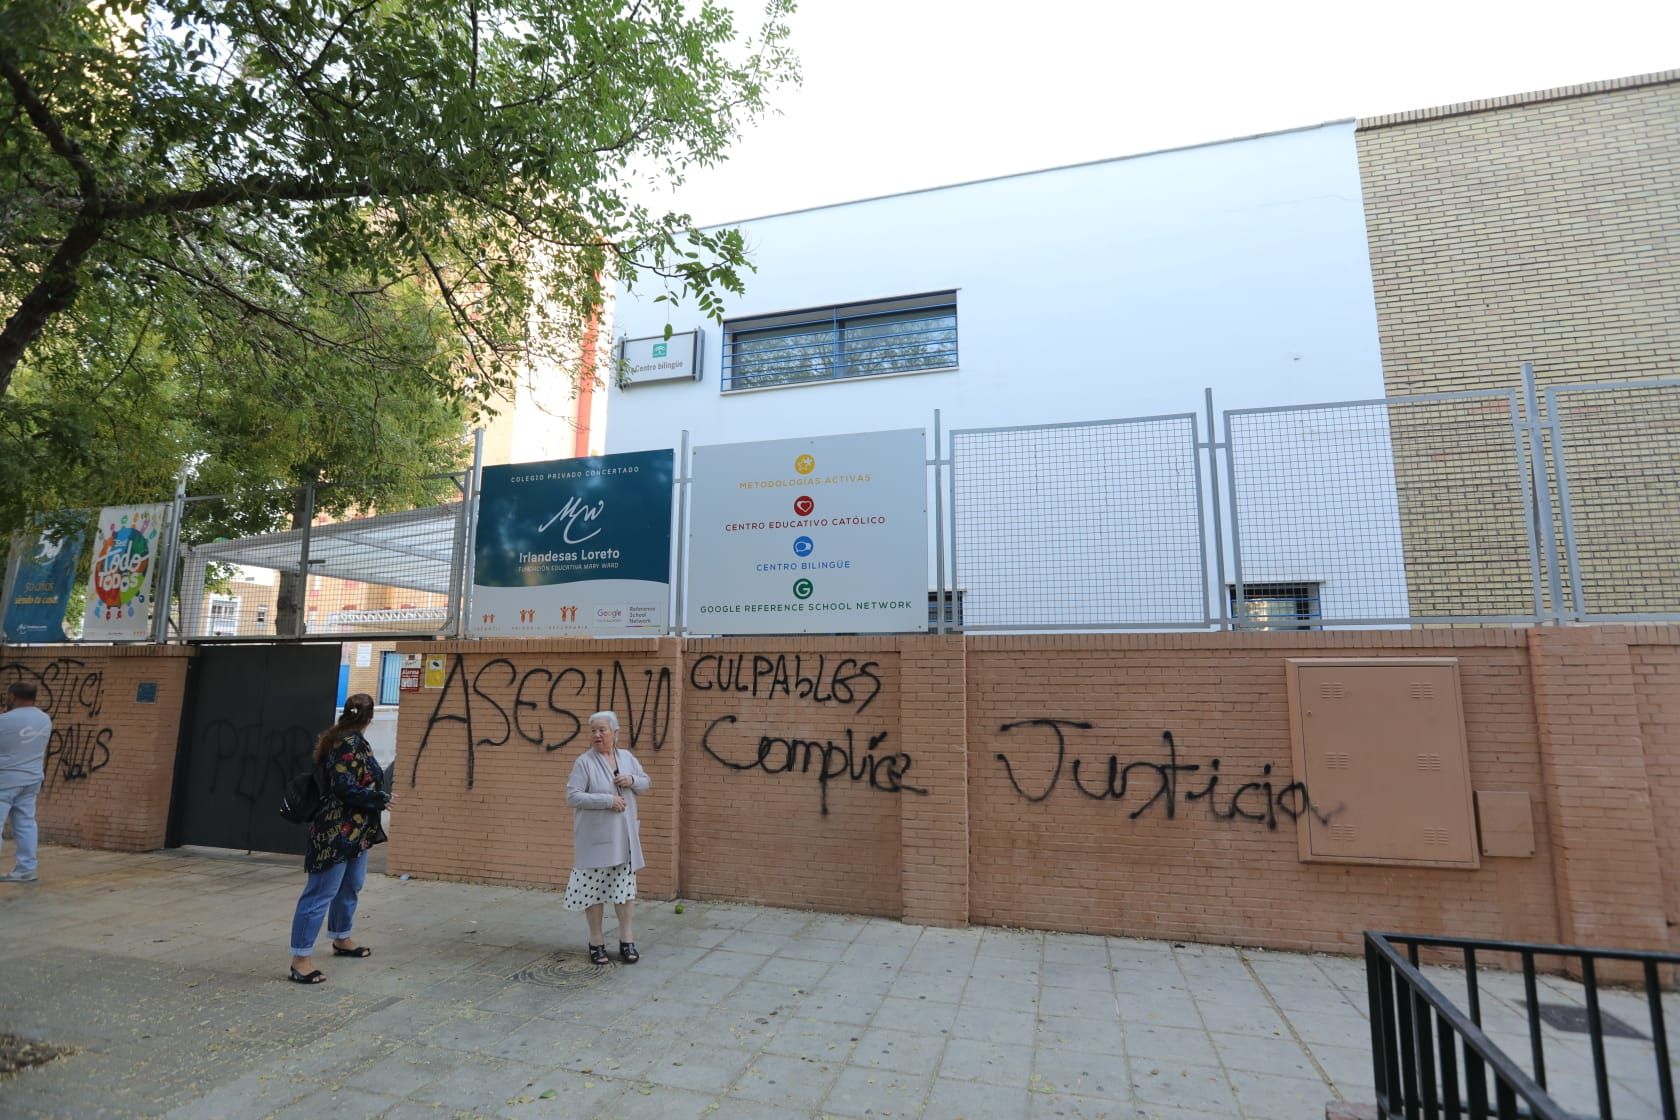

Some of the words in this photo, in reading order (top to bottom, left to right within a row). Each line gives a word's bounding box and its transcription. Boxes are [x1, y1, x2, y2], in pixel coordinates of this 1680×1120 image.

[635, 364, 656, 373] Centro
[657, 360, 683, 370] bilingüe
[511, 474, 544, 483] COLEGIO
[547, 471, 582, 480] PRIVADO
[585, 466, 639, 477] CONCERTADO
[824, 474, 872, 485] ACTIVAS
[725, 522, 765, 531] CENTRO
[769, 519, 828, 529] EDUCATIVO
[832, 516, 886, 526] CATÓLICO
[97, 541, 150, 575] Todo
[519, 550, 577, 563] Irlandesas
[581, 548, 620, 560] Loreto
[519, 565, 549, 573] FUNDACIÓN
[551, 564, 582, 572] EDUCATIVA
[756, 563, 797, 572] CENTRO
[801, 560, 850, 570] BILINGÜE
[98, 571, 140, 592] TODOS
[597, 608, 622, 618] Google
[700, 604, 741, 614] GOOGLE
[745, 603, 804, 613] REFERENCE
[808, 602, 852, 611] SCHOOL
[856, 601, 912, 610] NETWORK
[412, 652, 671, 790] ASESINO
[997, 718, 1345, 832] Justicia
